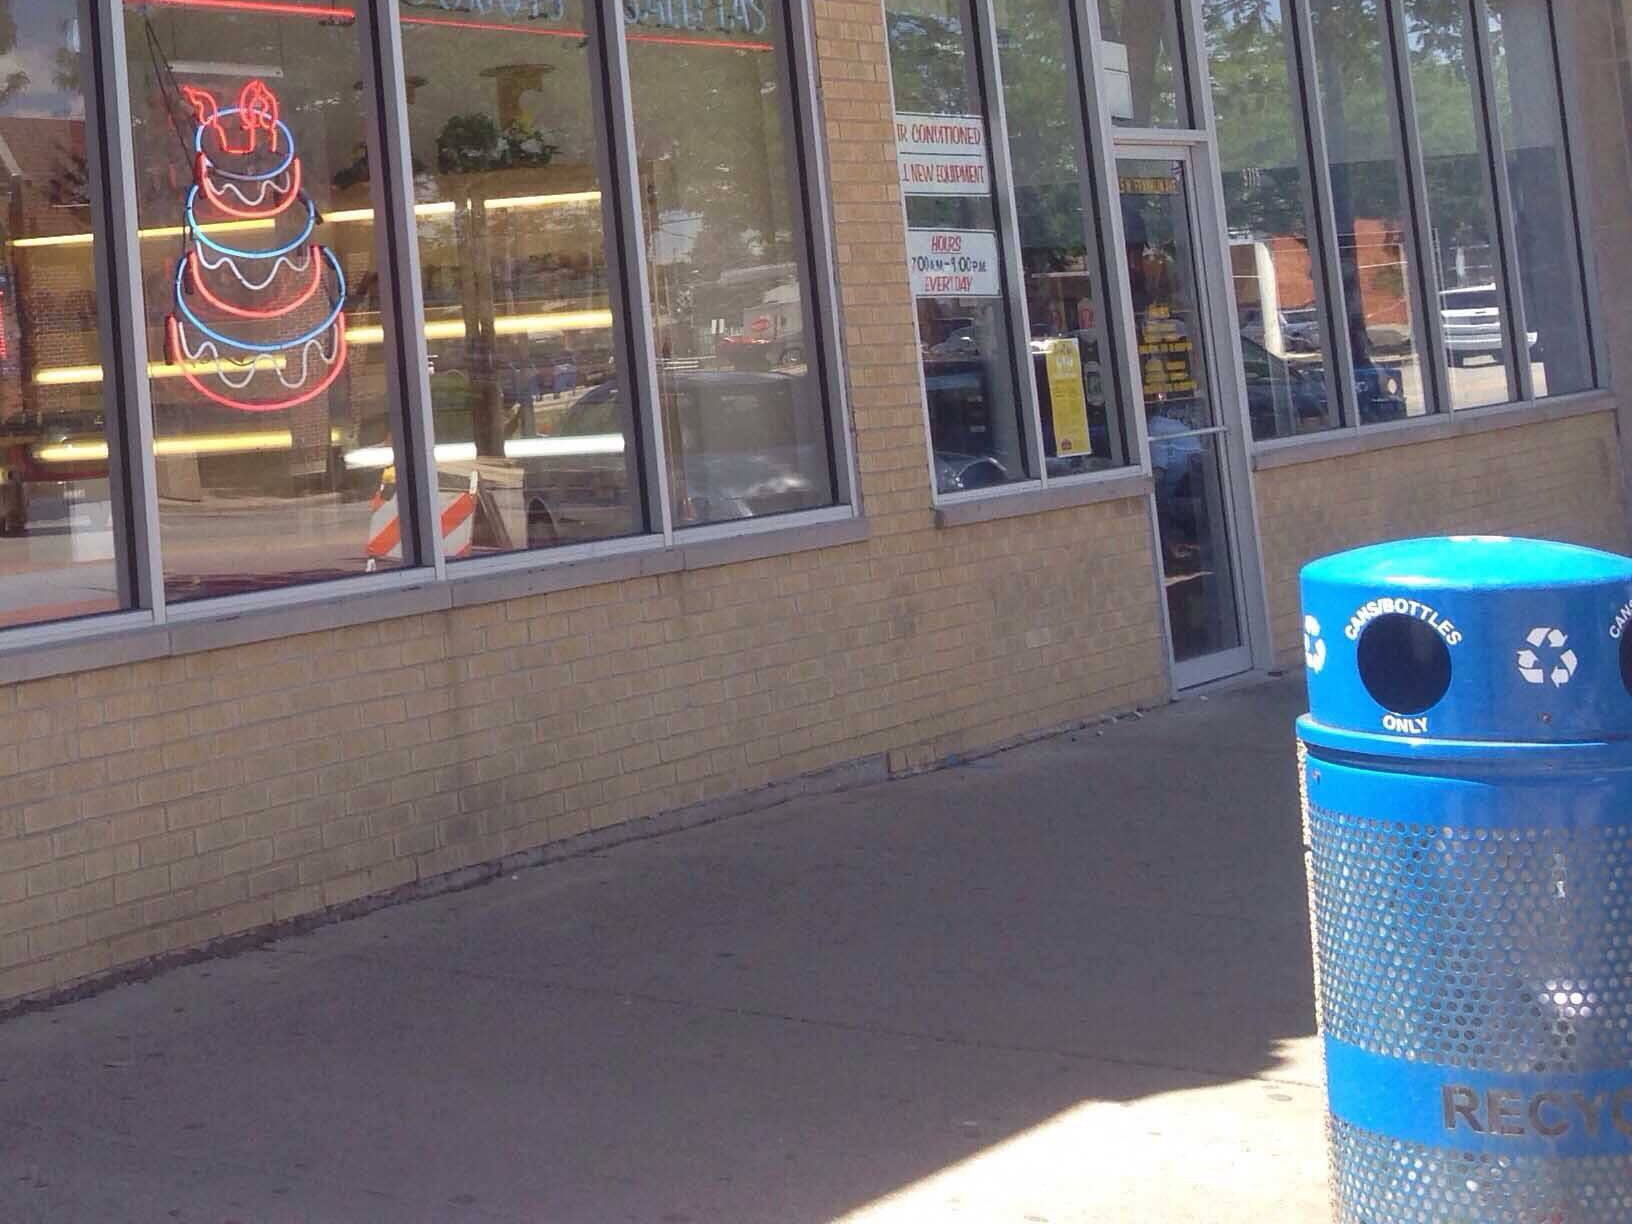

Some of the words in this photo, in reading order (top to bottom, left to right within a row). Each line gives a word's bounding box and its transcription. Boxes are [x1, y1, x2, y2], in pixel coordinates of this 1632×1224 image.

[912, 123, 981, 144] CONDITIONED
[911, 163, 934, 183] NEW
[936, 164, 984, 184] EQUIPMENT
[931, 236, 961, 252] HOURS
[1344, 598, 1463, 646] CANS/BOTTLES
[1609, 599, 1632, 639] CAN
[1382, 714, 1430, 734] ONLY
